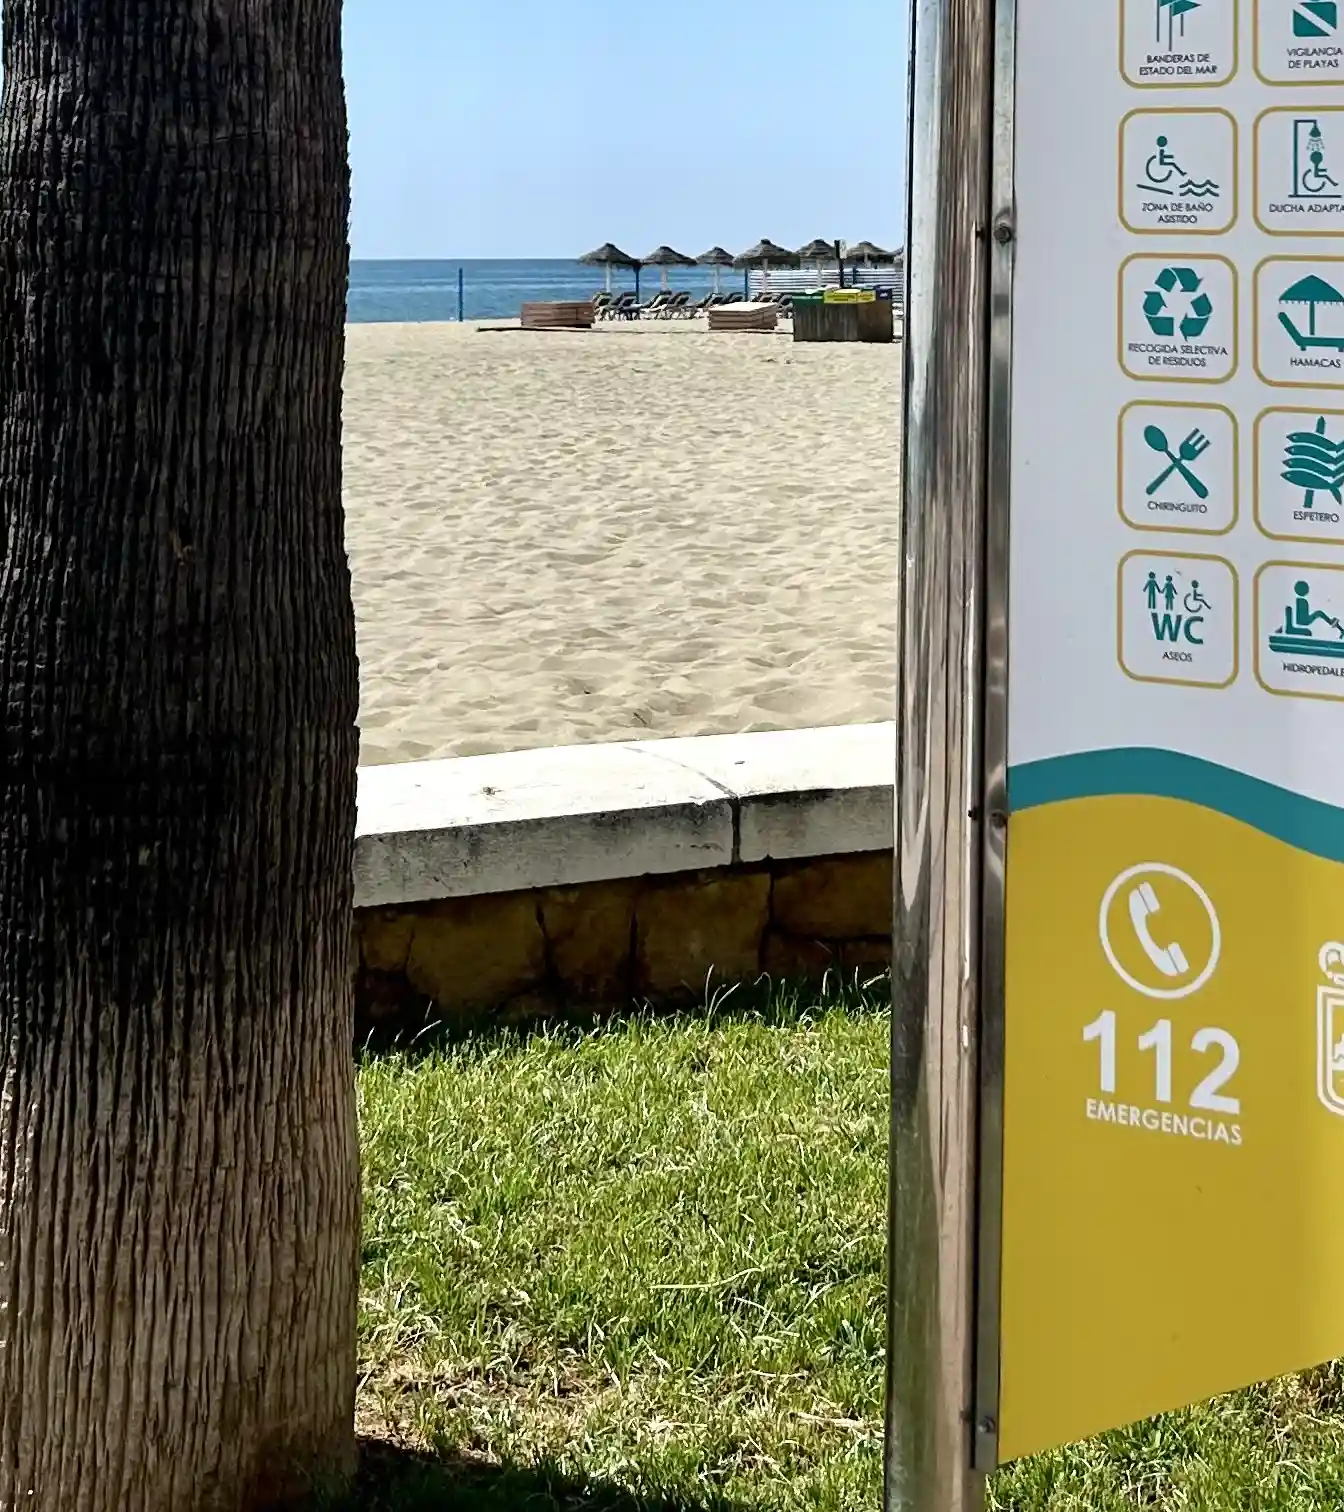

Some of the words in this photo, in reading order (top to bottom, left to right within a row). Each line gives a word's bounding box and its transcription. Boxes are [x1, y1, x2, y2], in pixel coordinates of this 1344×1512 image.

[1286, 46, 1344, 58] VIGILANCIA
[1146, 53, 1196, 65] BANDERAS
[1196, 53, 1211, 64] DE
[1288, 59, 1302, 70] DE
[1303, 58, 1340, 70] PLAYAS
[1138, 66, 1176, 77] ESTADO
[1176, 65, 1194, 76] DEL
[1195, 65, 1219, 75] MAR
[1141, 202, 1169, 212] ZONA
[1170, 202, 1185, 212] DE
[1185, 201, 1214, 213] BAÑO
[1268, 202, 1306, 214] DUCHA
[1157, 214, 1199, 224] ASISTIDO
[1127, 342, 1179, 354] RECOGIDA
[1179, 344, 1229, 357] SELECTIVA
[1148, 355, 1163, 366] DE
[1162, 356, 1207, 368] RESIDUOS
[1289, 357, 1342, 369] HAMACAS
[1146, 500, 1209, 515] CHIRINGUITO
[1293, 510, 1341, 524] ESPETERO
[1151, 612, 1205, 646] WC
[1161, 650, 1194, 663] ASEOS
[1082, 1008, 1241, 1116] 112
[1085, 1096, 1243, 1146] EMERGENCIAS
